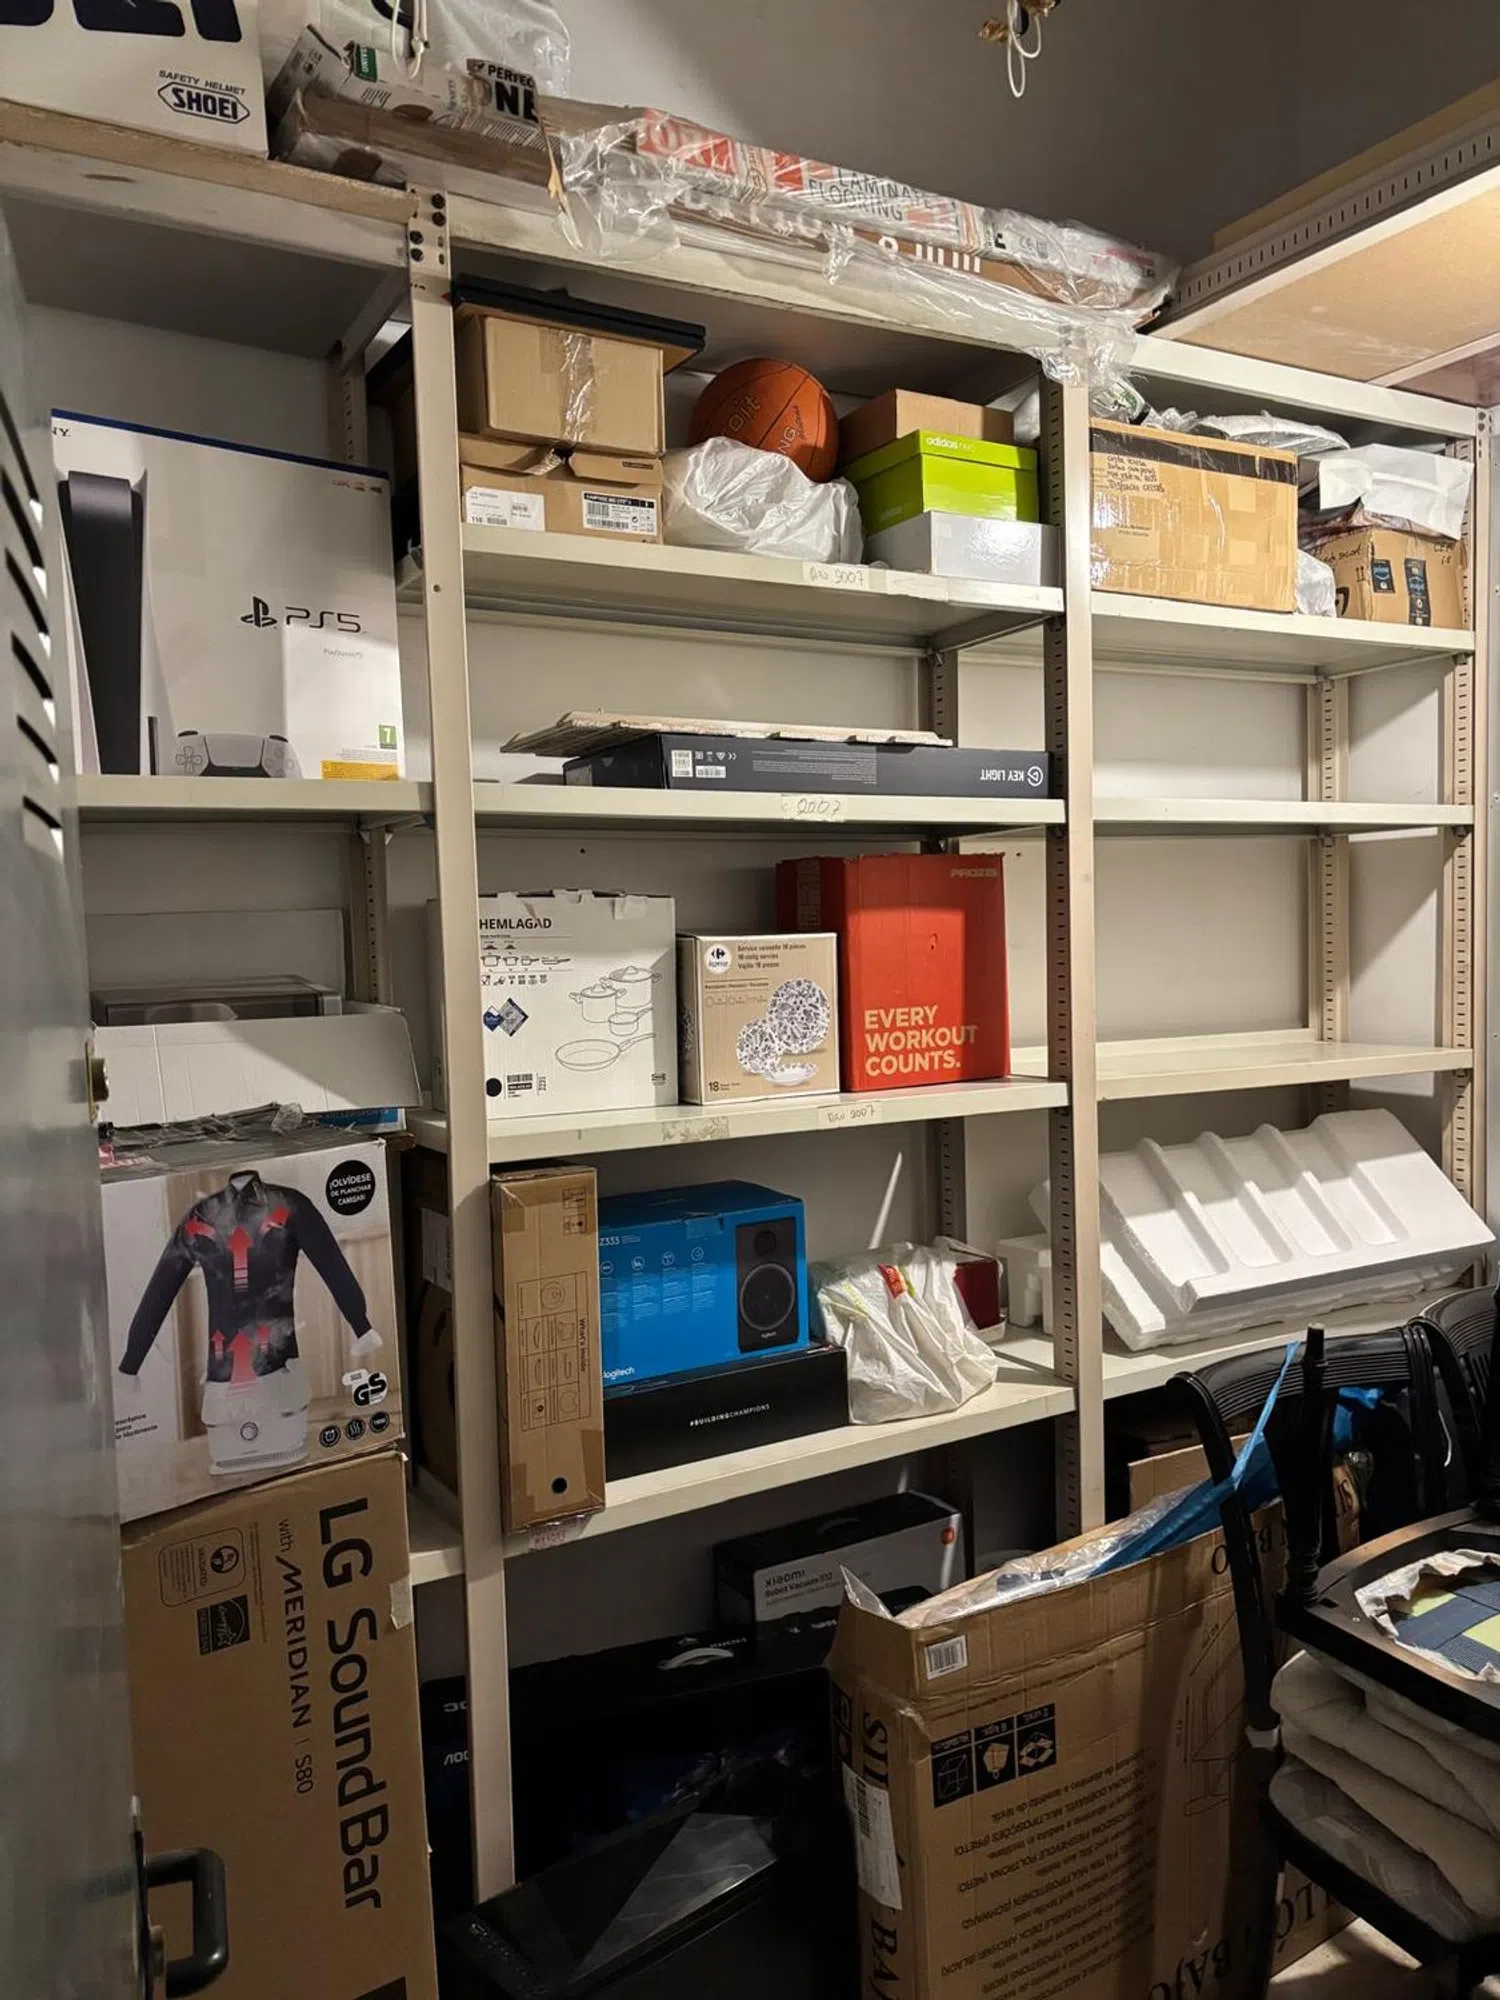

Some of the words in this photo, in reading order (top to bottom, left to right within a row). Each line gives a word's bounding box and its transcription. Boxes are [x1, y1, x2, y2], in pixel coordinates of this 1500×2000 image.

[158, 69, 200, 86] SAFETY
[204, 80, 247, 96] HELMET
[171, 87, 239, 120] SHOEI
[808, 178, 903, 222] FLOORING
[925, 436, 958, 449] adidas
[284, 605, 363, 634] PS5
[383, 727, 391, 744] 7
[979, 767, 1006, 781] LIGHT
[1007, 768, 1025, 782] KEY
[478, 917, 553, 930] HEMLAGAD
[864, 1004, 939, 1030] EVERY
[865, 1024, 979, 1052] WORKOUT
[865, 1050, 961, 1077] COUNTS.
[708, 1080, 720, 1093] 18
[578, 1317, 588, 1346] What's
[601, 1365, 636, 1380] logitech
[353, 1371, 387, 1407] GS
[689, 1403, 771, 1428] #BUILDINGCHAMPIONS
[276, 1517, 294, 1552] with
[318, 1496, 376, 1589] LG
[764, 1569, 806, 1587] xiaomi
[765, 1585, 789, 1598] Robot
[275, 1554, 313, 1731] MERIDIAN
[293, 1752, 315, 1795] S80
